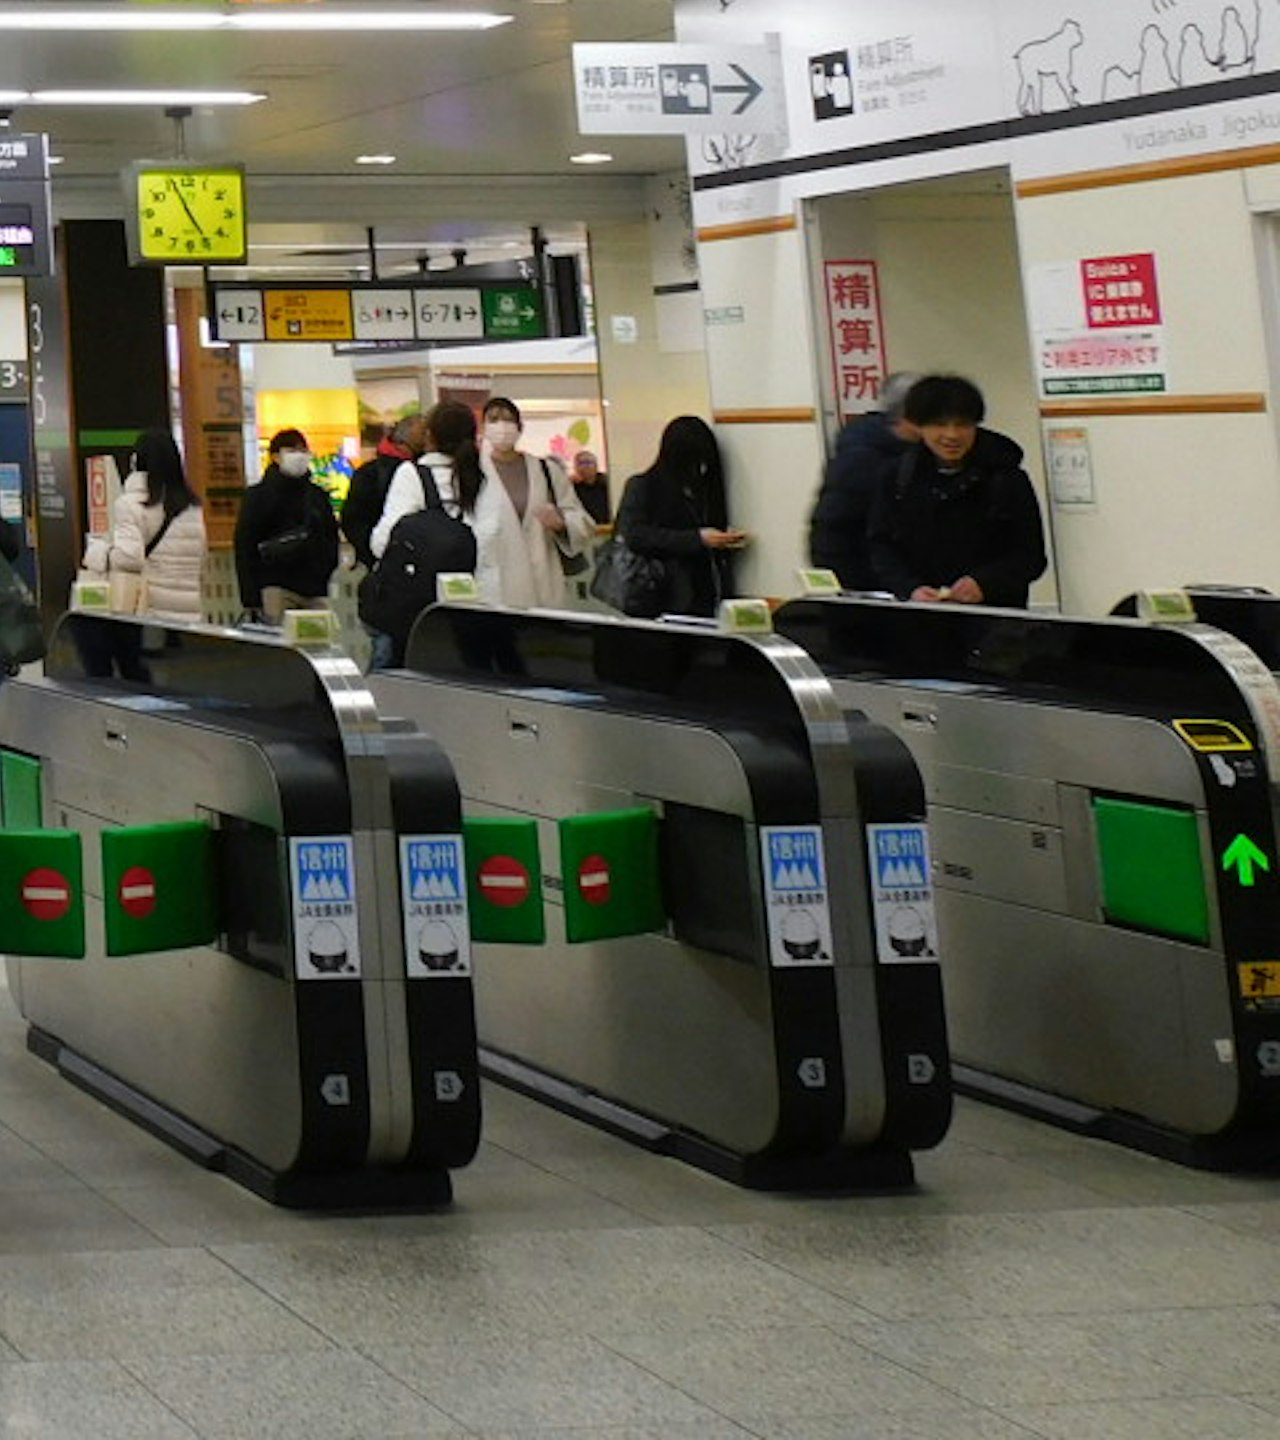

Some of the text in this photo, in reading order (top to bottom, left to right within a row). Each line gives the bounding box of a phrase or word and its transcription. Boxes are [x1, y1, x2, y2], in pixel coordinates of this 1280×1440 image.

[1123, 119, 1209, 150] Yudanaka
[247, 306, 260, 325] 2
[832, 272, 881, 401] 精算所
[771, 835, 816, 860] 信州
[876, 832, 922, 857] 信州
[300, 844, 345, 871] 信州
[410, 844, 456, 871] 信州
[807, 1064, 820, 1081] 3
[913, 1061, 927, 1078] 2
[441, 1077, 453, 1094] 3
